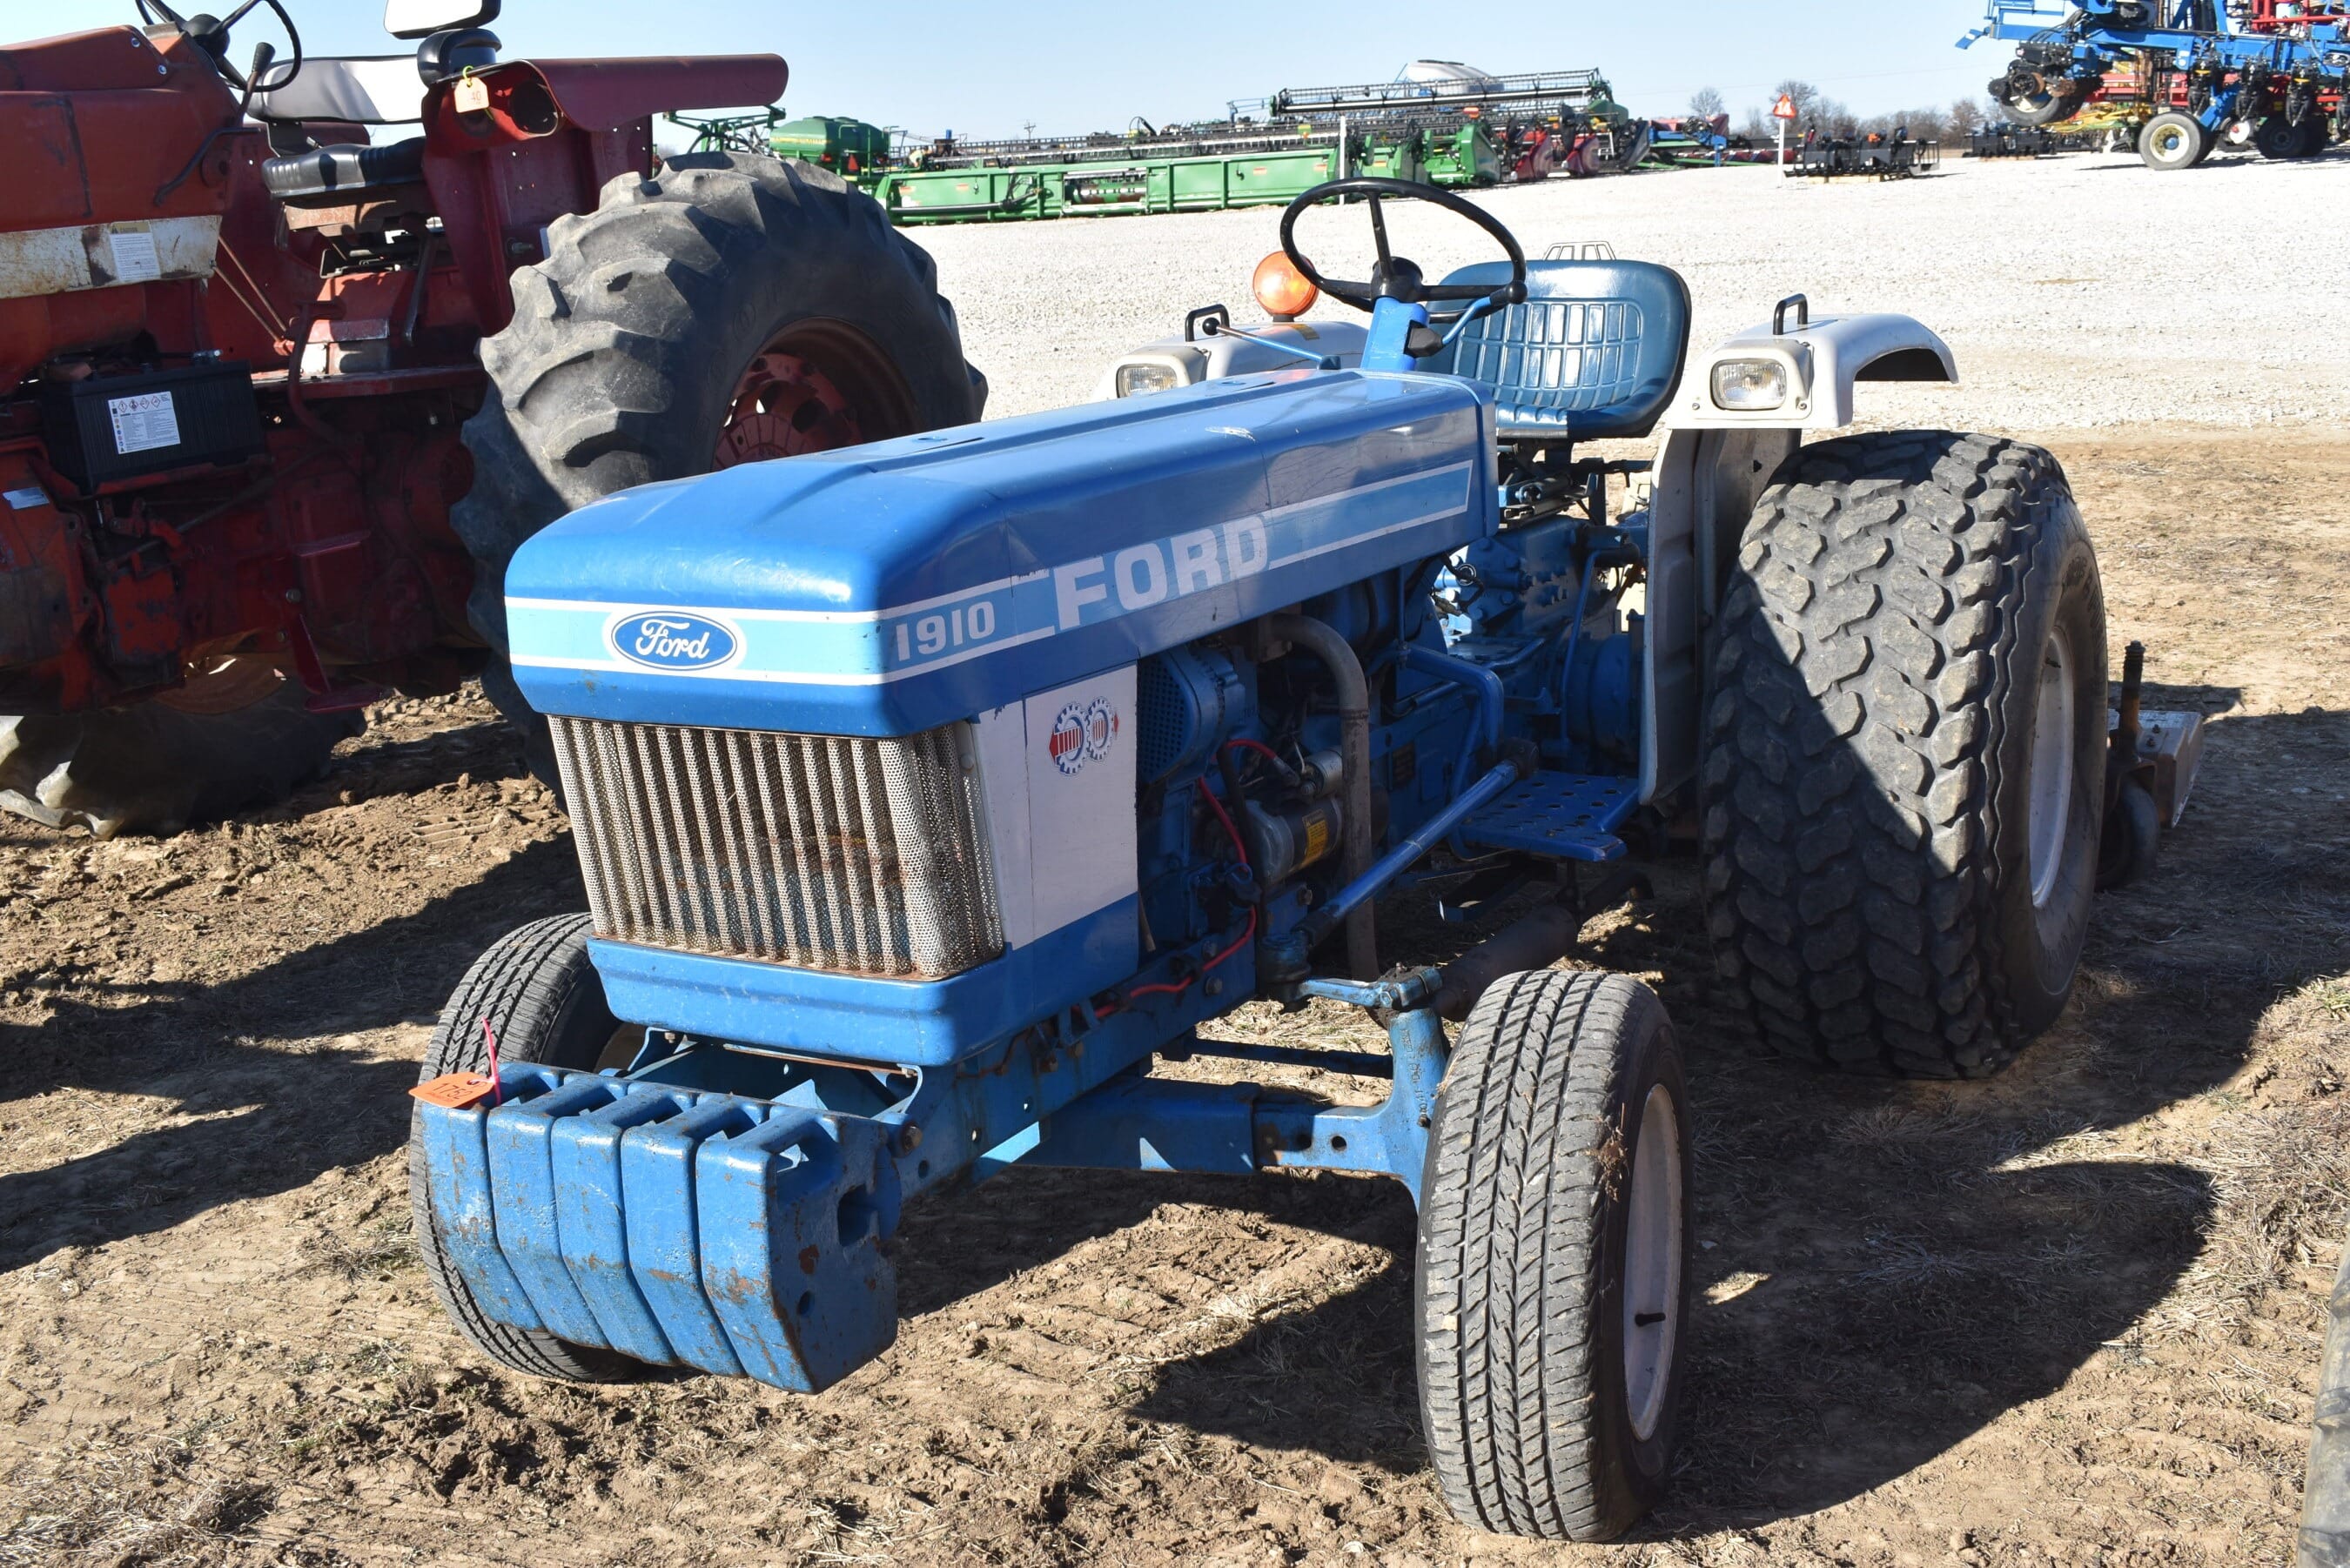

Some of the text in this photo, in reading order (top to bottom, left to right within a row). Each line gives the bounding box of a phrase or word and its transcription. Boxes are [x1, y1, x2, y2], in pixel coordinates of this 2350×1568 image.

[896, 515, 1268, 662] 1910 FORD
[635, 619, 710, 660] Ford
[433, 1082, 473, 1100] 1752
